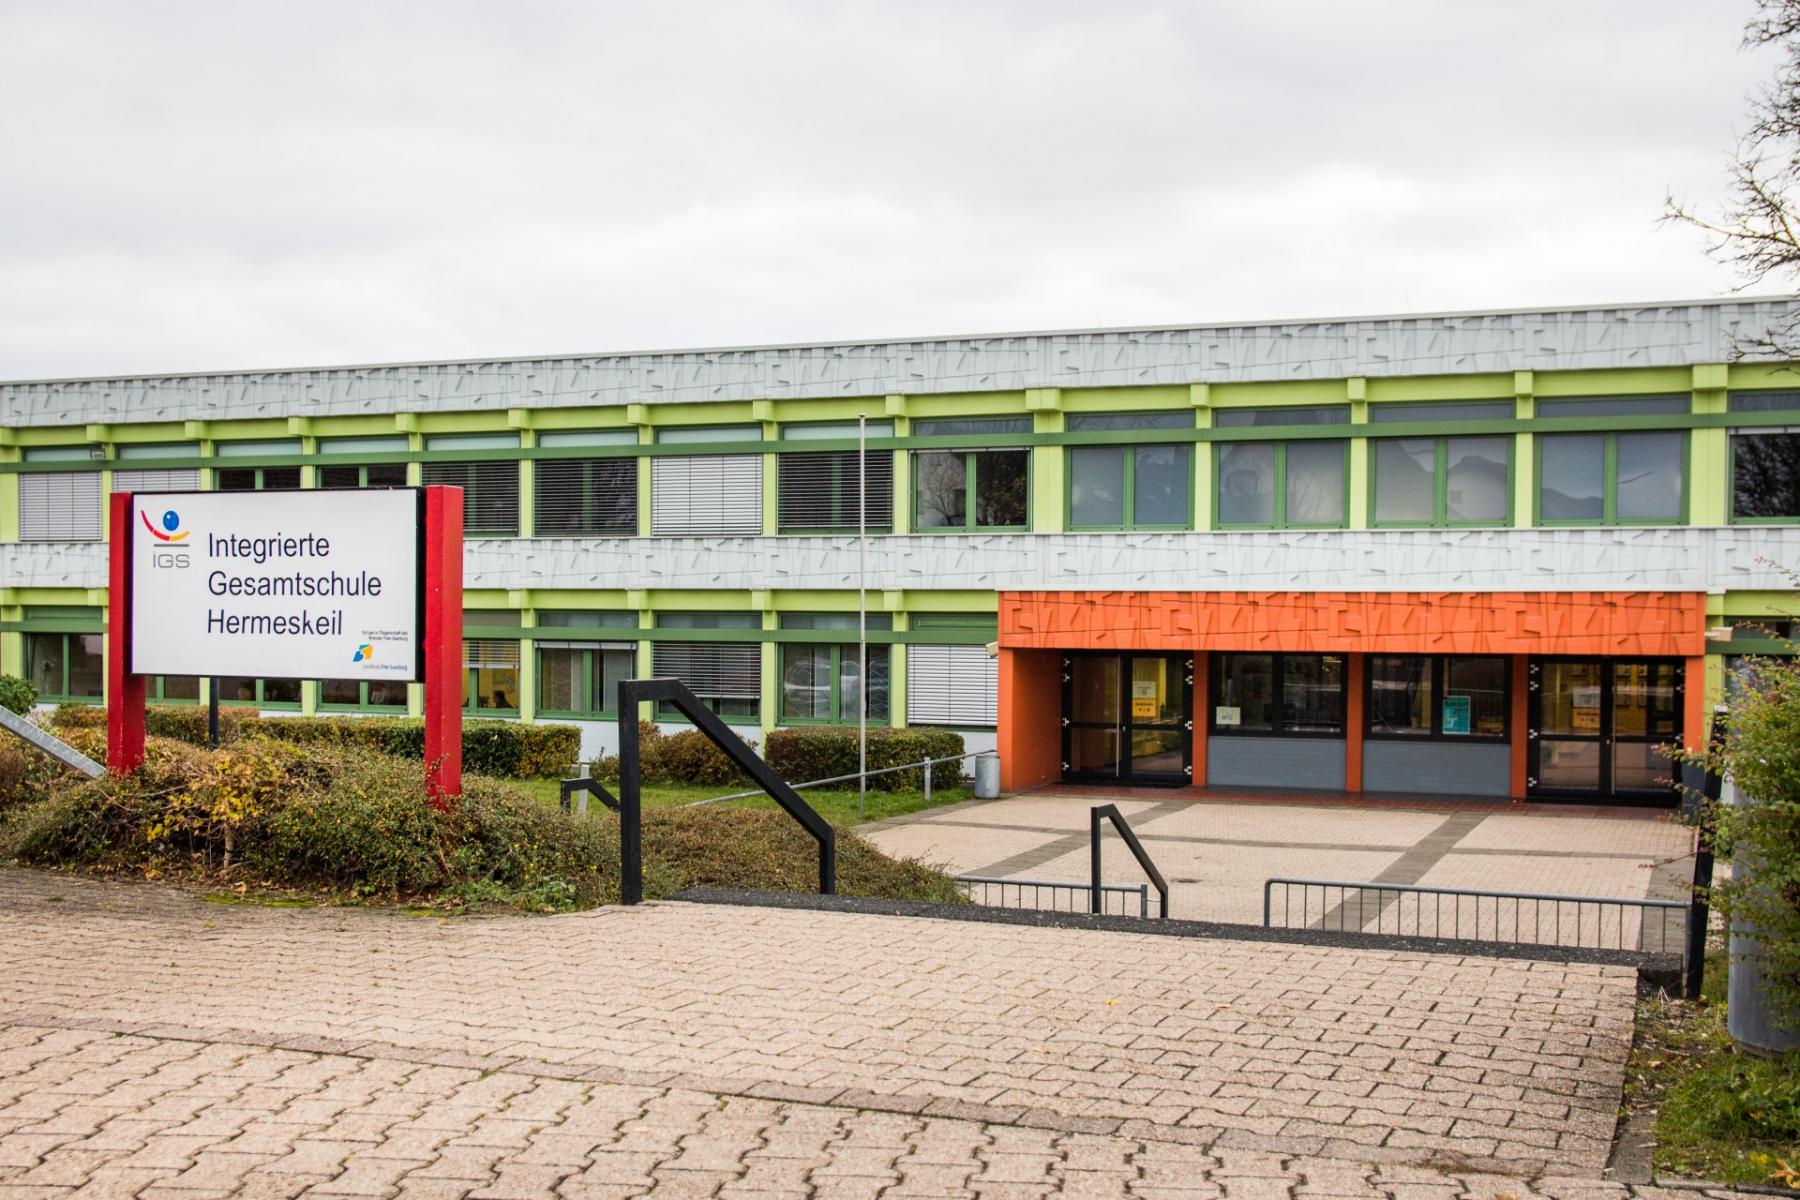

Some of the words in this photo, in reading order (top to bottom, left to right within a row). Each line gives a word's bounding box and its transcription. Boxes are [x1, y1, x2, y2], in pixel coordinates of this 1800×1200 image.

[208, 532, 330, 564] Integrierte
[208, 570, 382, 597] Gesamtschule
[207, 608, 342, 636] Hermeskeil
